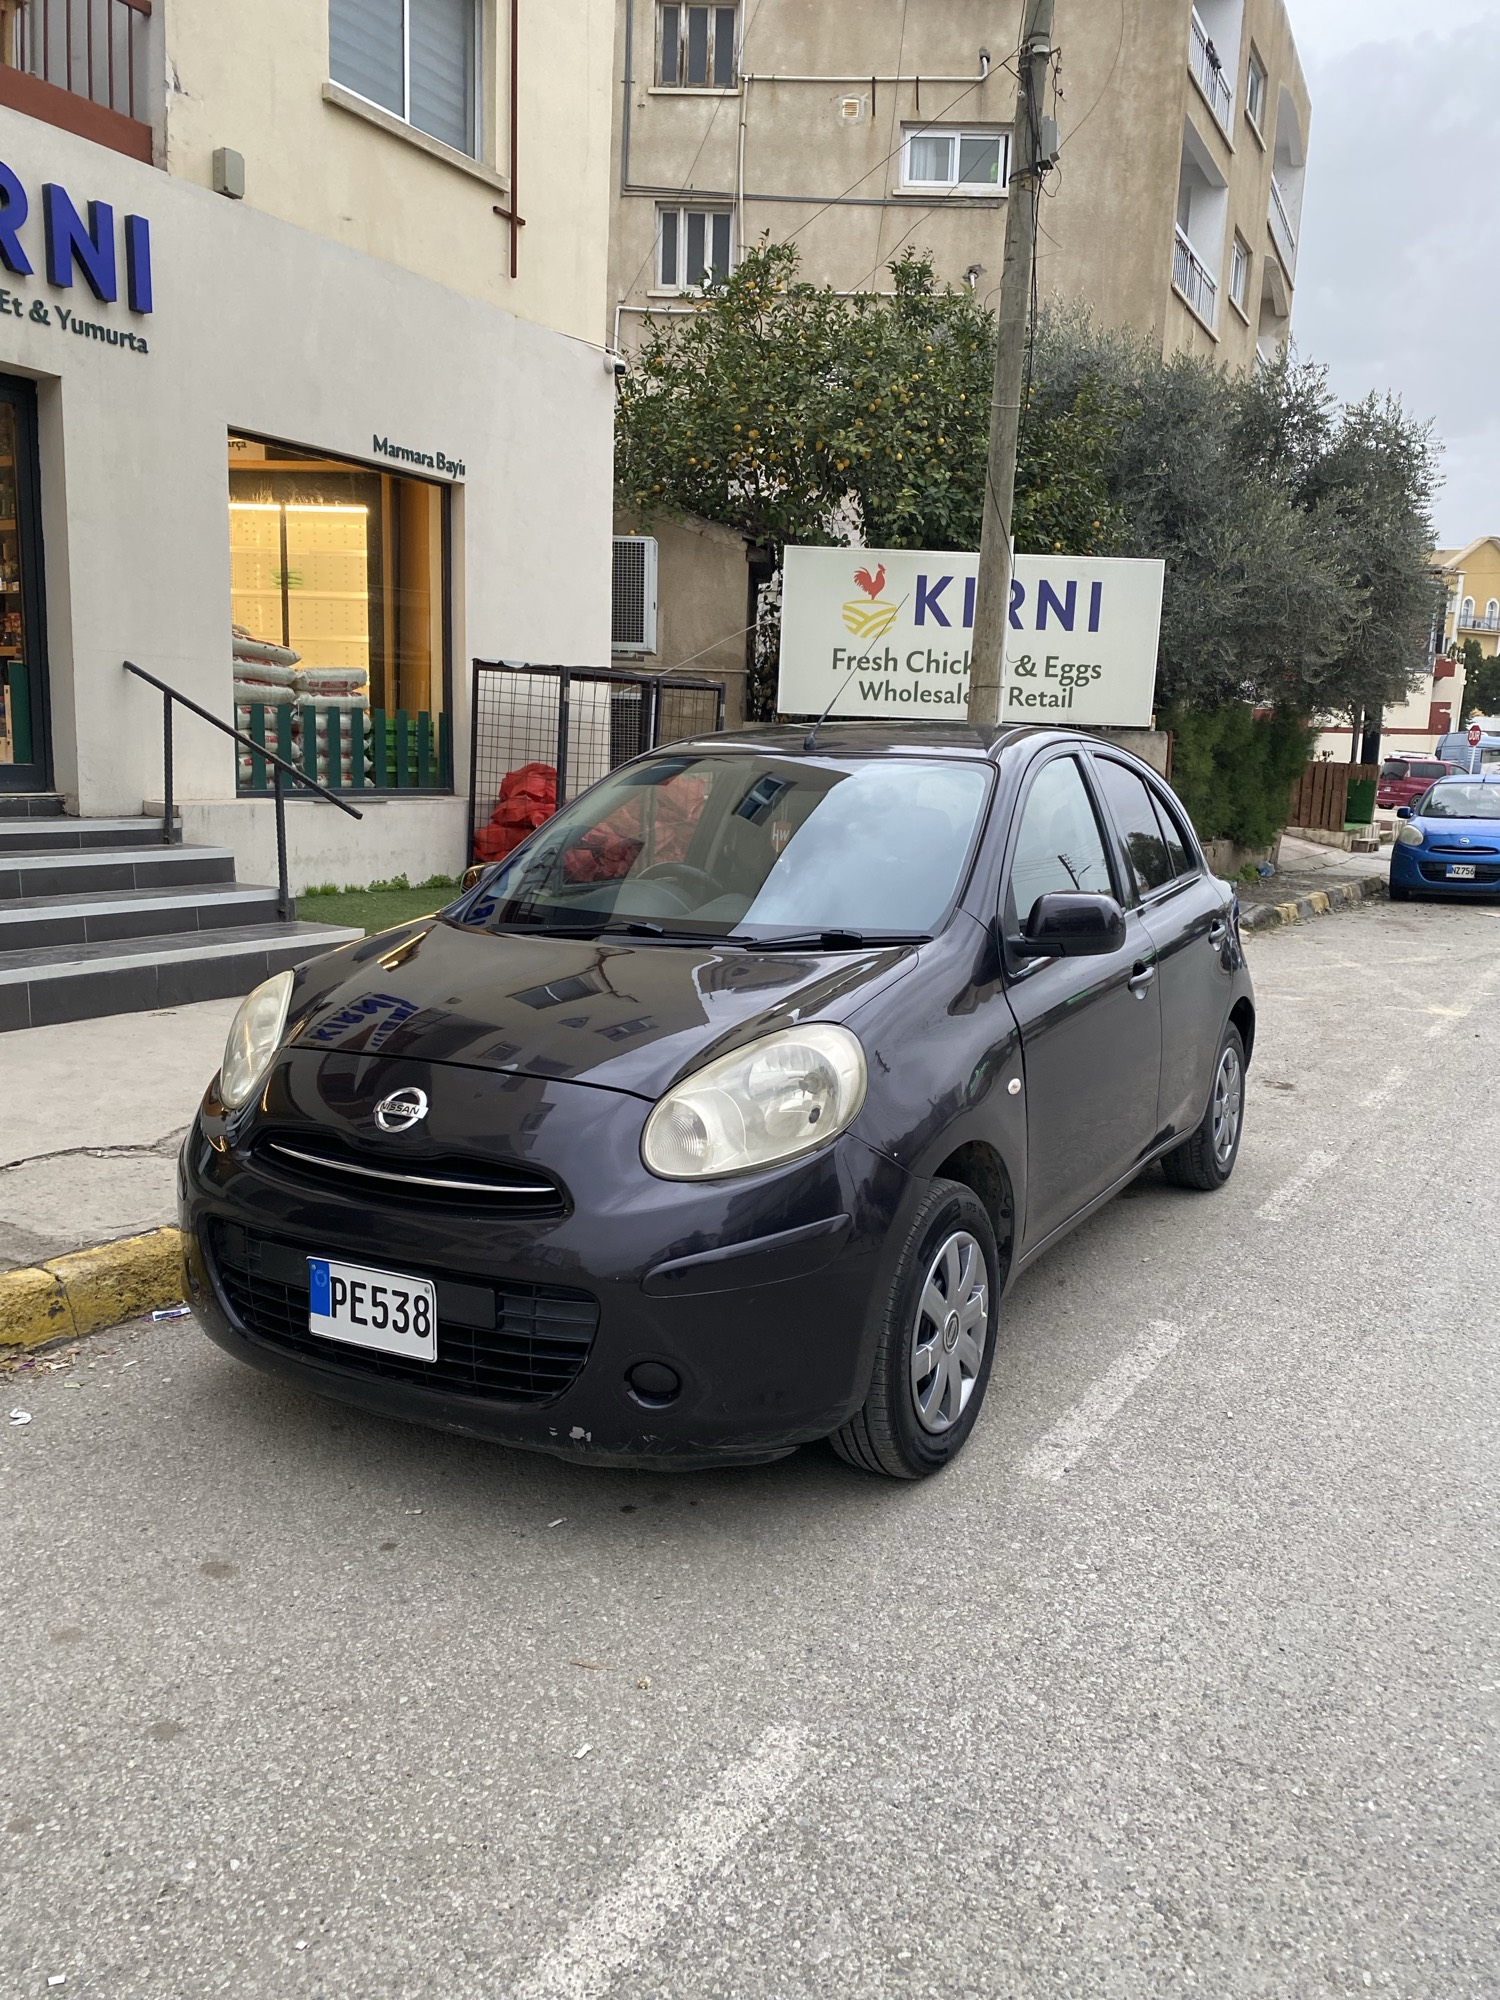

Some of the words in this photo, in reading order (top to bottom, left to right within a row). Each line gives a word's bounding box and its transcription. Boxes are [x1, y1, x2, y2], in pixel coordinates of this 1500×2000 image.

[29, 299, 51, 326] &
[55, 305, 149, 354] Yumurta
[373, 434, 435, 469] Marmara
[832, 647, 898, 672] Fresh
[1014, 654, 1037, 678] &
[1045, 655, 1102, 687] Eggs
[1008, 686, 1073, 708] Retail
[1468, 730, 1480, 741] DUR
[380, 1102, 420, 1115] NISSAN
[330, 1276, 431, 1338] PE538
